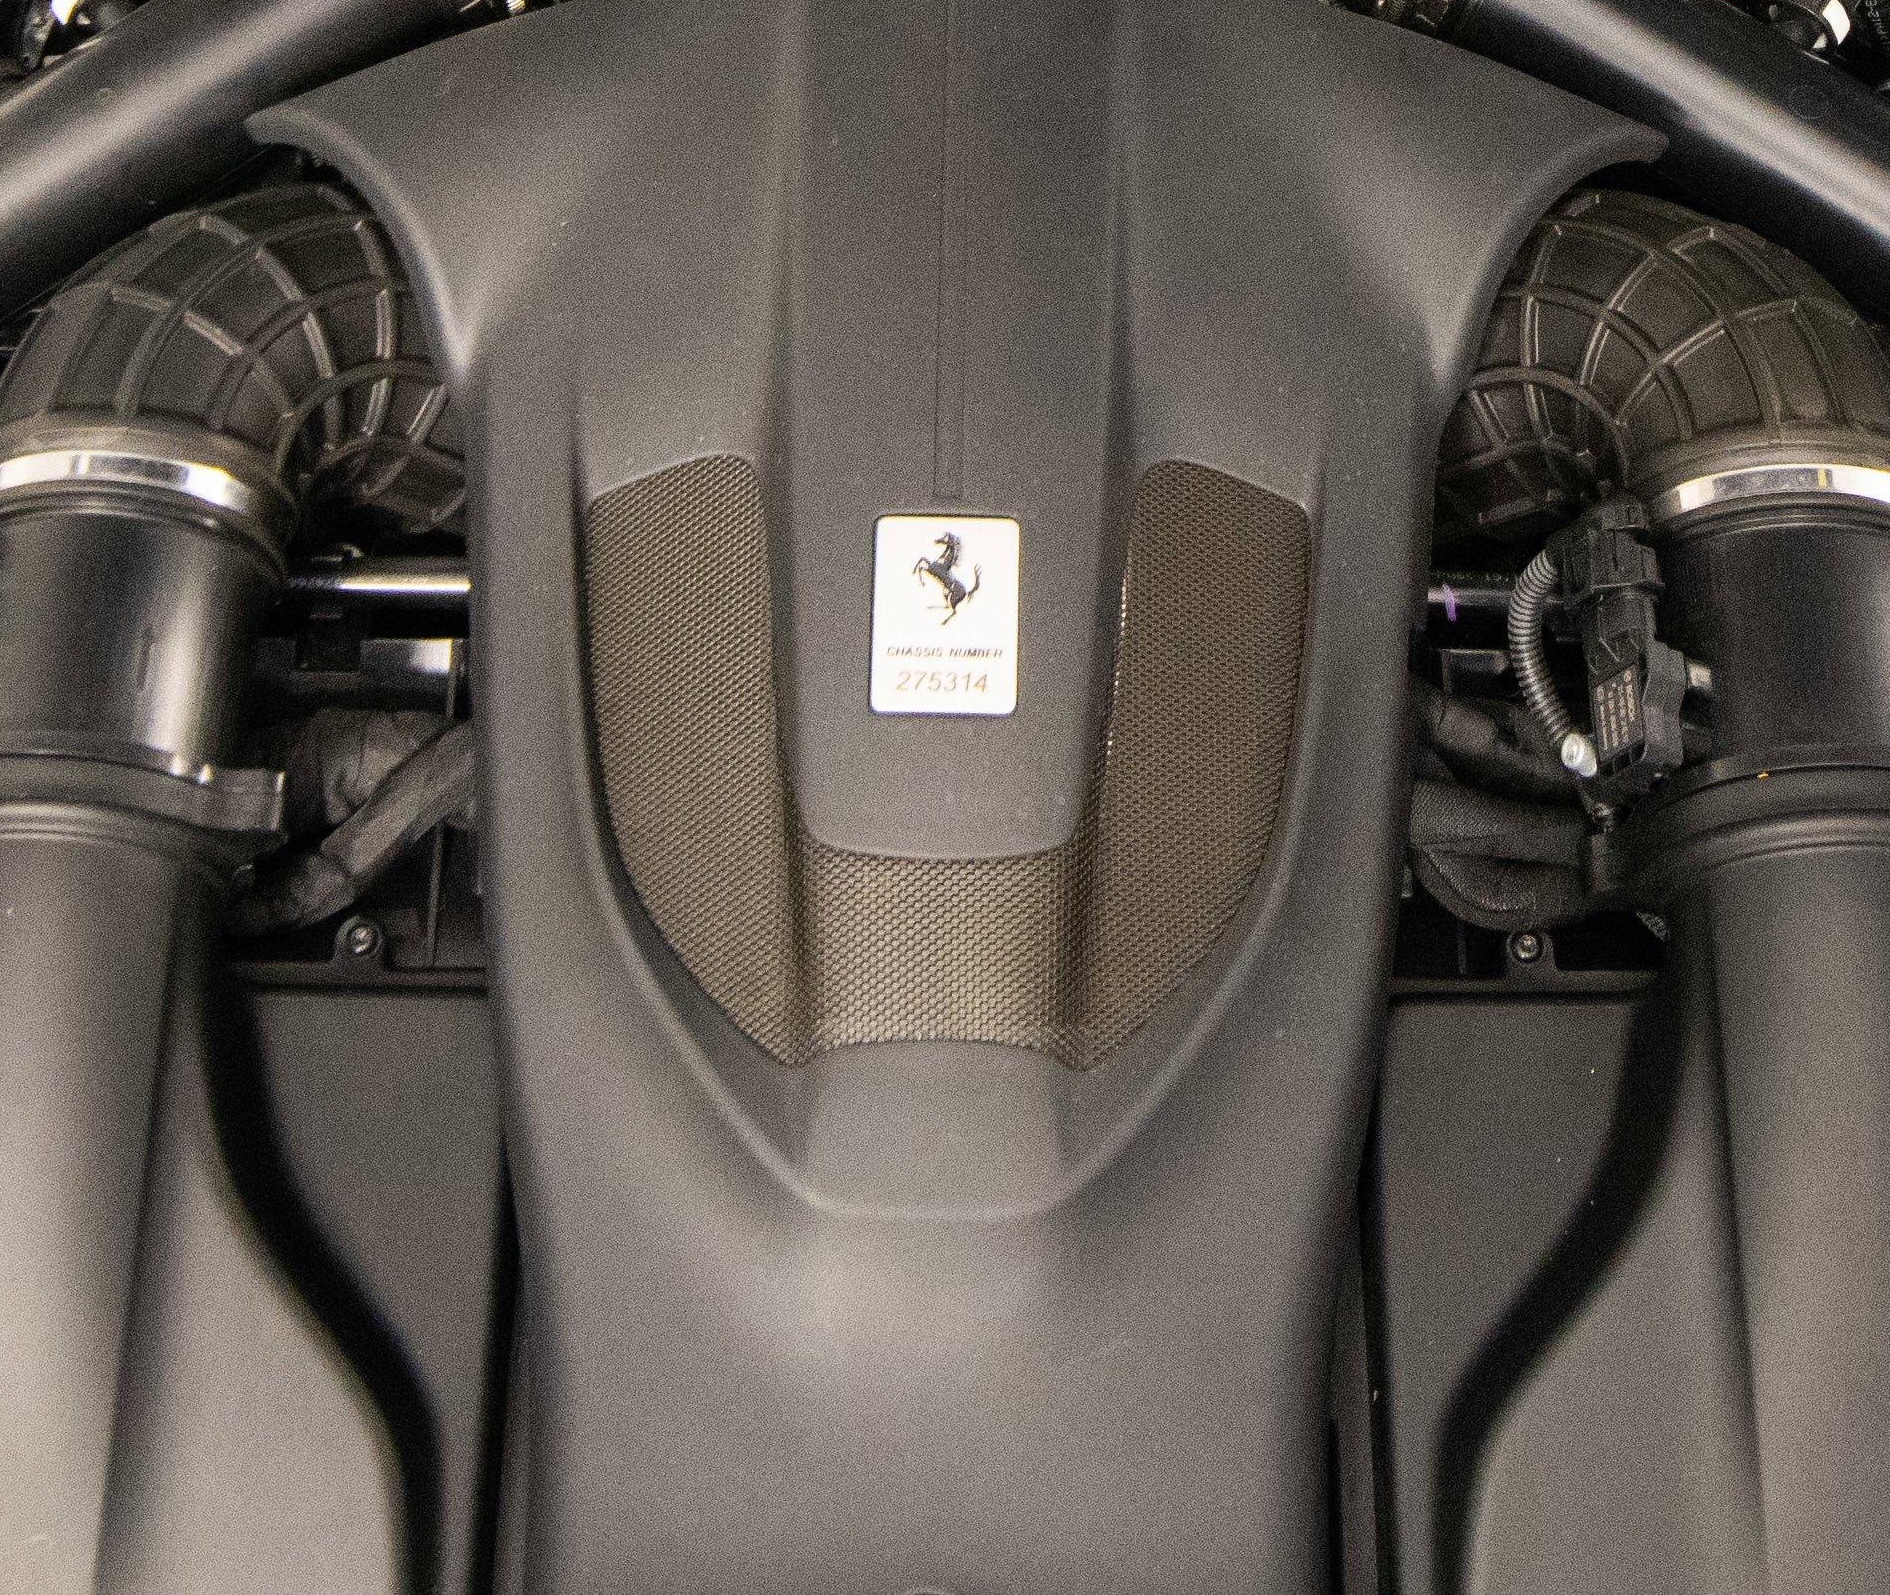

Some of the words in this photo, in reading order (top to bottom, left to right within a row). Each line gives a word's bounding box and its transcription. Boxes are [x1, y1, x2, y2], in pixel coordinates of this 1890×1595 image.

[886, 645, 944, 658] CHASSIS
[949, 646, 1003, 659] NUMBER
[895, 669, 989, 694] 275314
